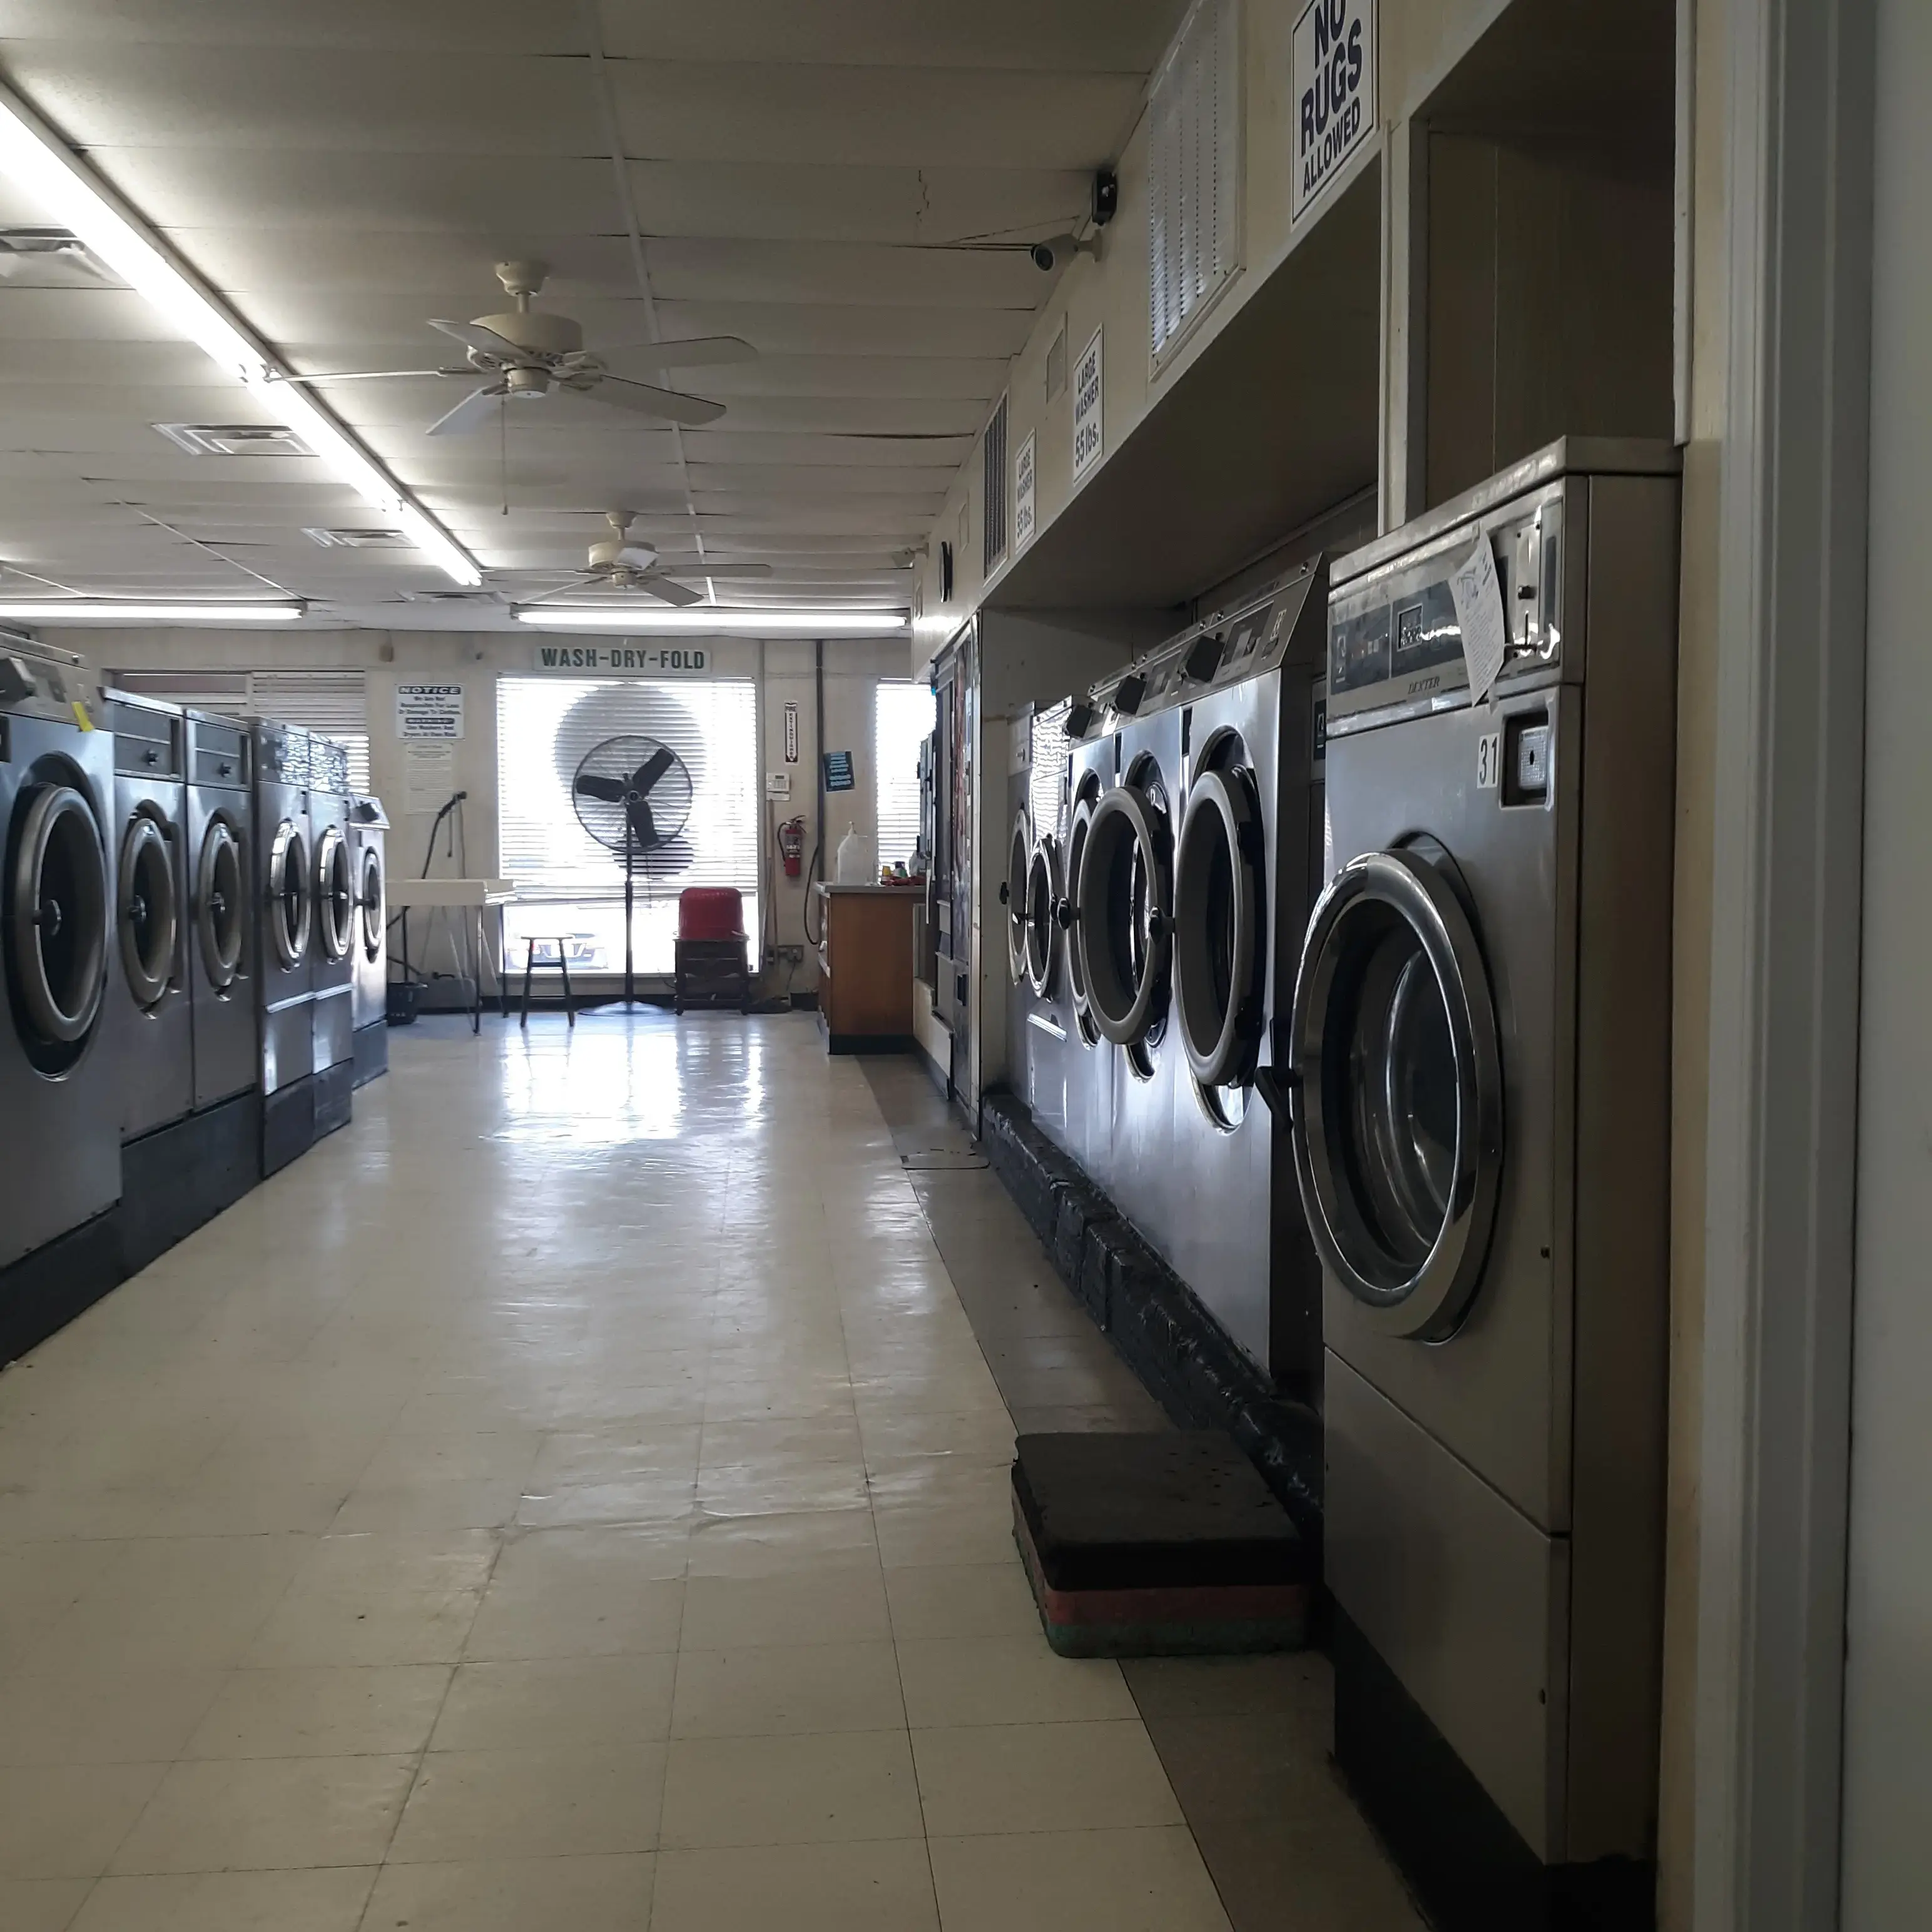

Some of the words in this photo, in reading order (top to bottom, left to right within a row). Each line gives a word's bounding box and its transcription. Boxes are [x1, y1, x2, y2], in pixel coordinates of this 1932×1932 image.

[1314, 0, 1345, 70] NO
[1301, 18, 1363, 158] RUGS
[1303, 96, 1361, 198] ALLOWED
[1077, 350, 1096, 396] LARGE
[1075, 375, 1099, 426] WASHER
[1408, 676, 1440, 694] DEXTER
[1479, 736, 1498, 785] 31
